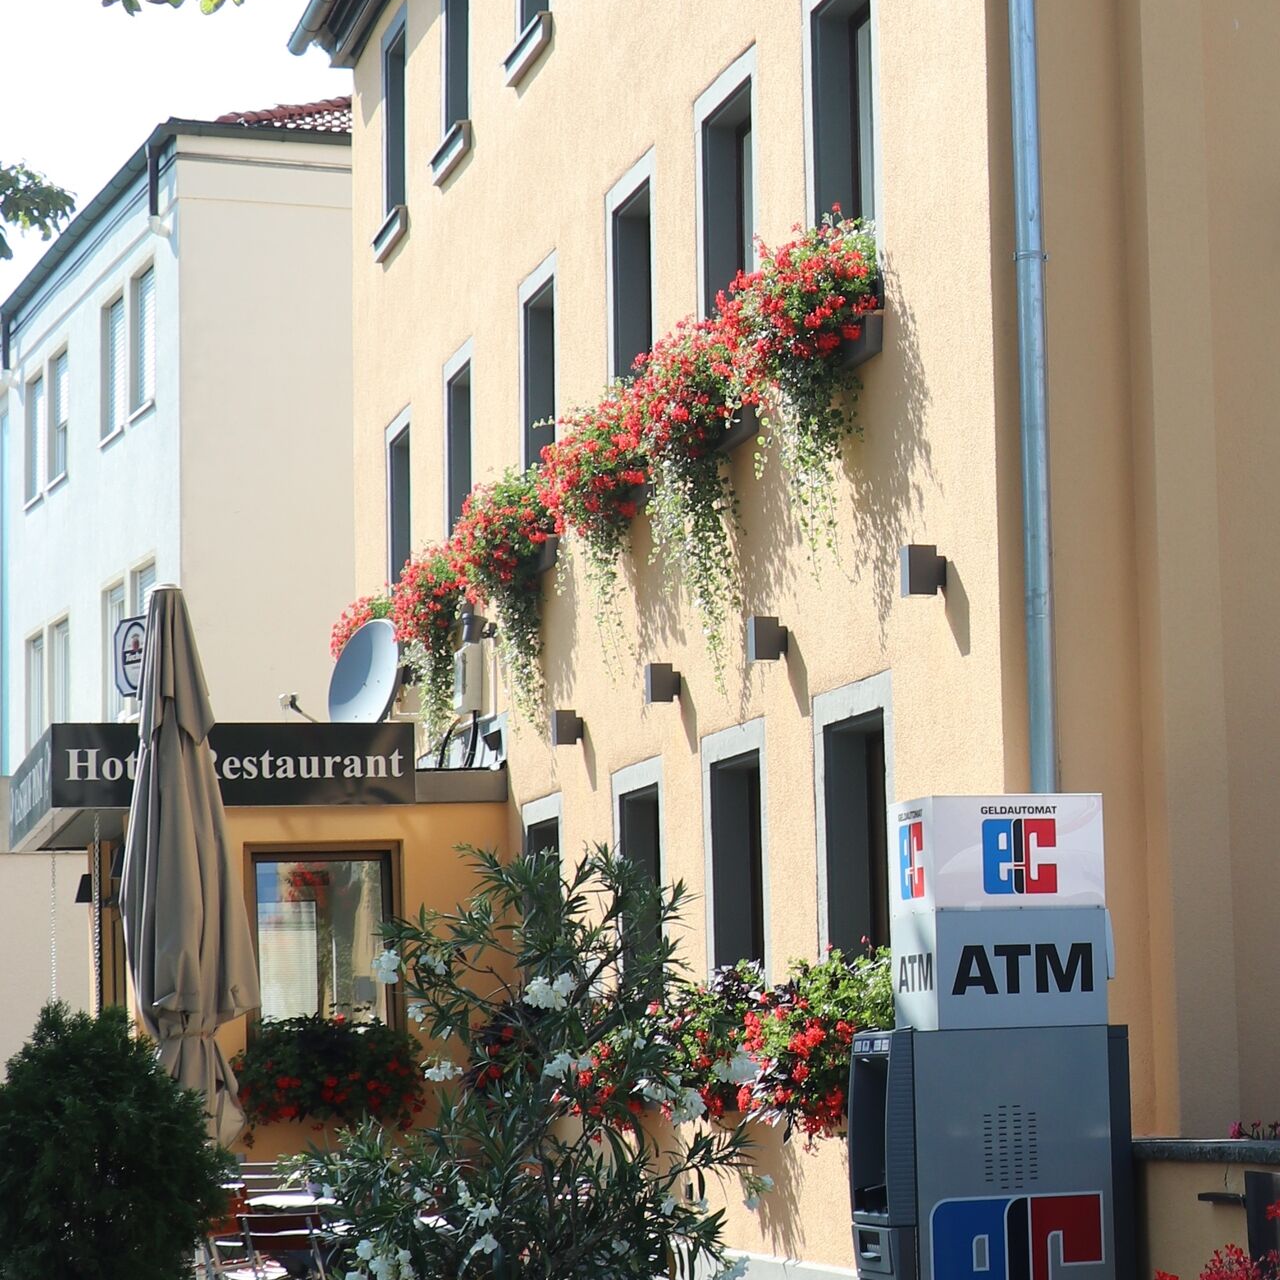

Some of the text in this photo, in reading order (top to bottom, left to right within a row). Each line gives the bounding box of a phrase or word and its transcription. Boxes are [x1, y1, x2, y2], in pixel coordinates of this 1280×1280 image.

[65, 748, 139, 781] Hot
[980, 805, 1057, 815] GELDAUTOMAT
[899, 952, 934, 994] ATM
[952, 942, 1094, 996] ATM
